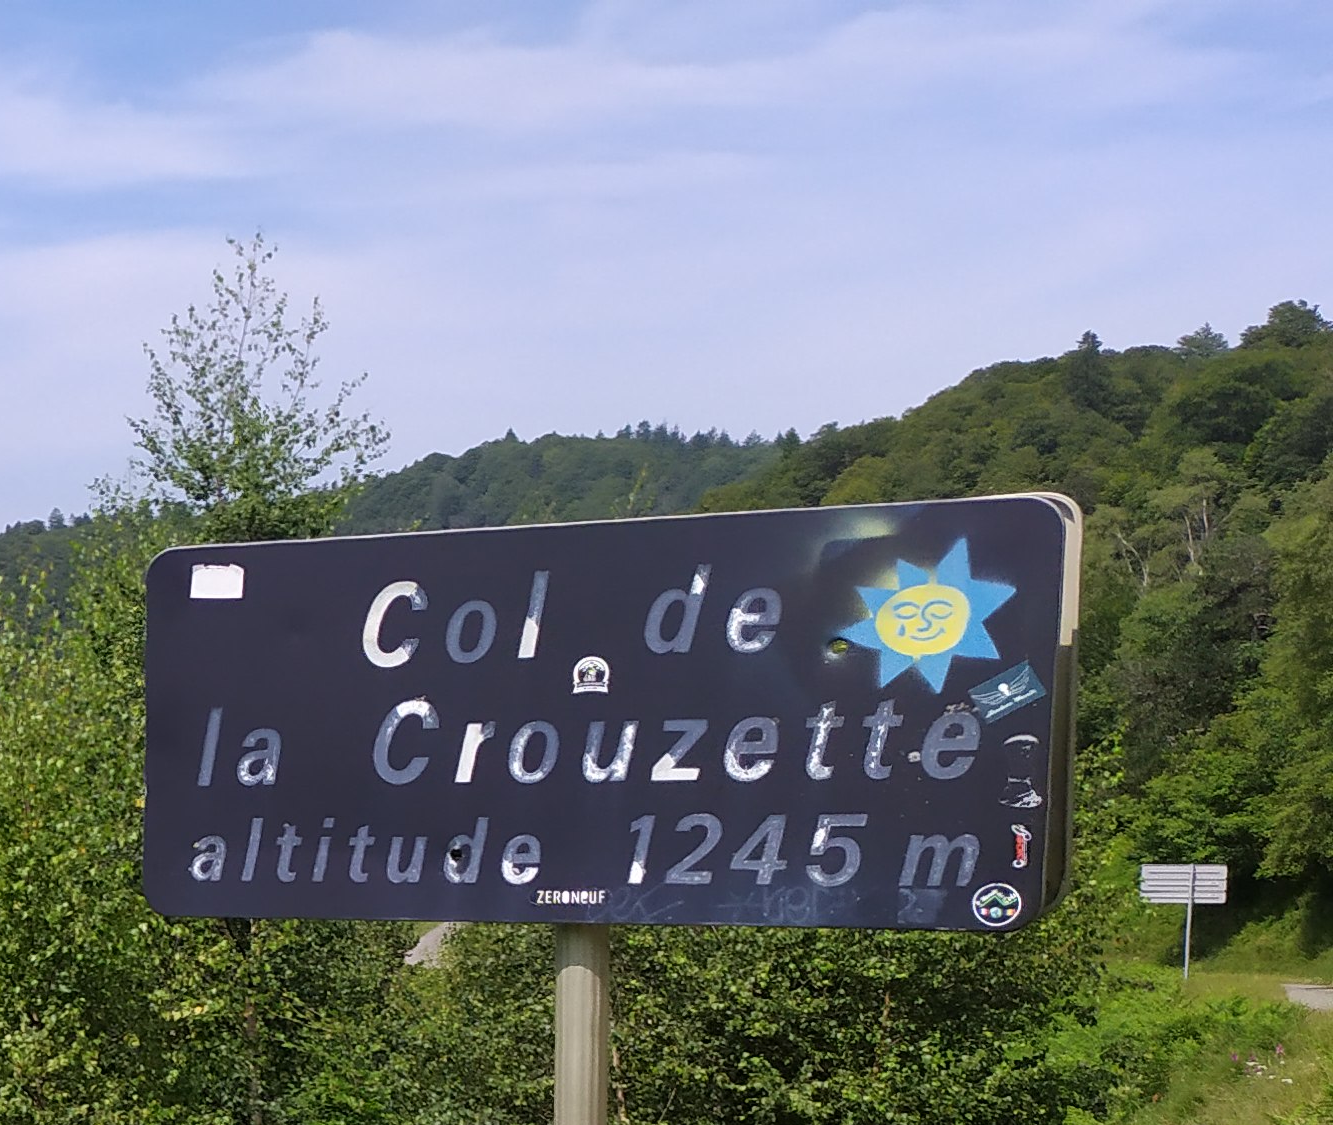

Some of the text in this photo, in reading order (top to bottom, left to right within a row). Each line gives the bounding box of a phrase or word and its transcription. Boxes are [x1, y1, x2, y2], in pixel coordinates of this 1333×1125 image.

[363, 564, 783, 668] Col de
[196, 697, 982, 786] la Crouzette
[189, 816, 542, 886] altitude
[627, 811, 869, 888] 1245
[898, 833, 982, 888] m
